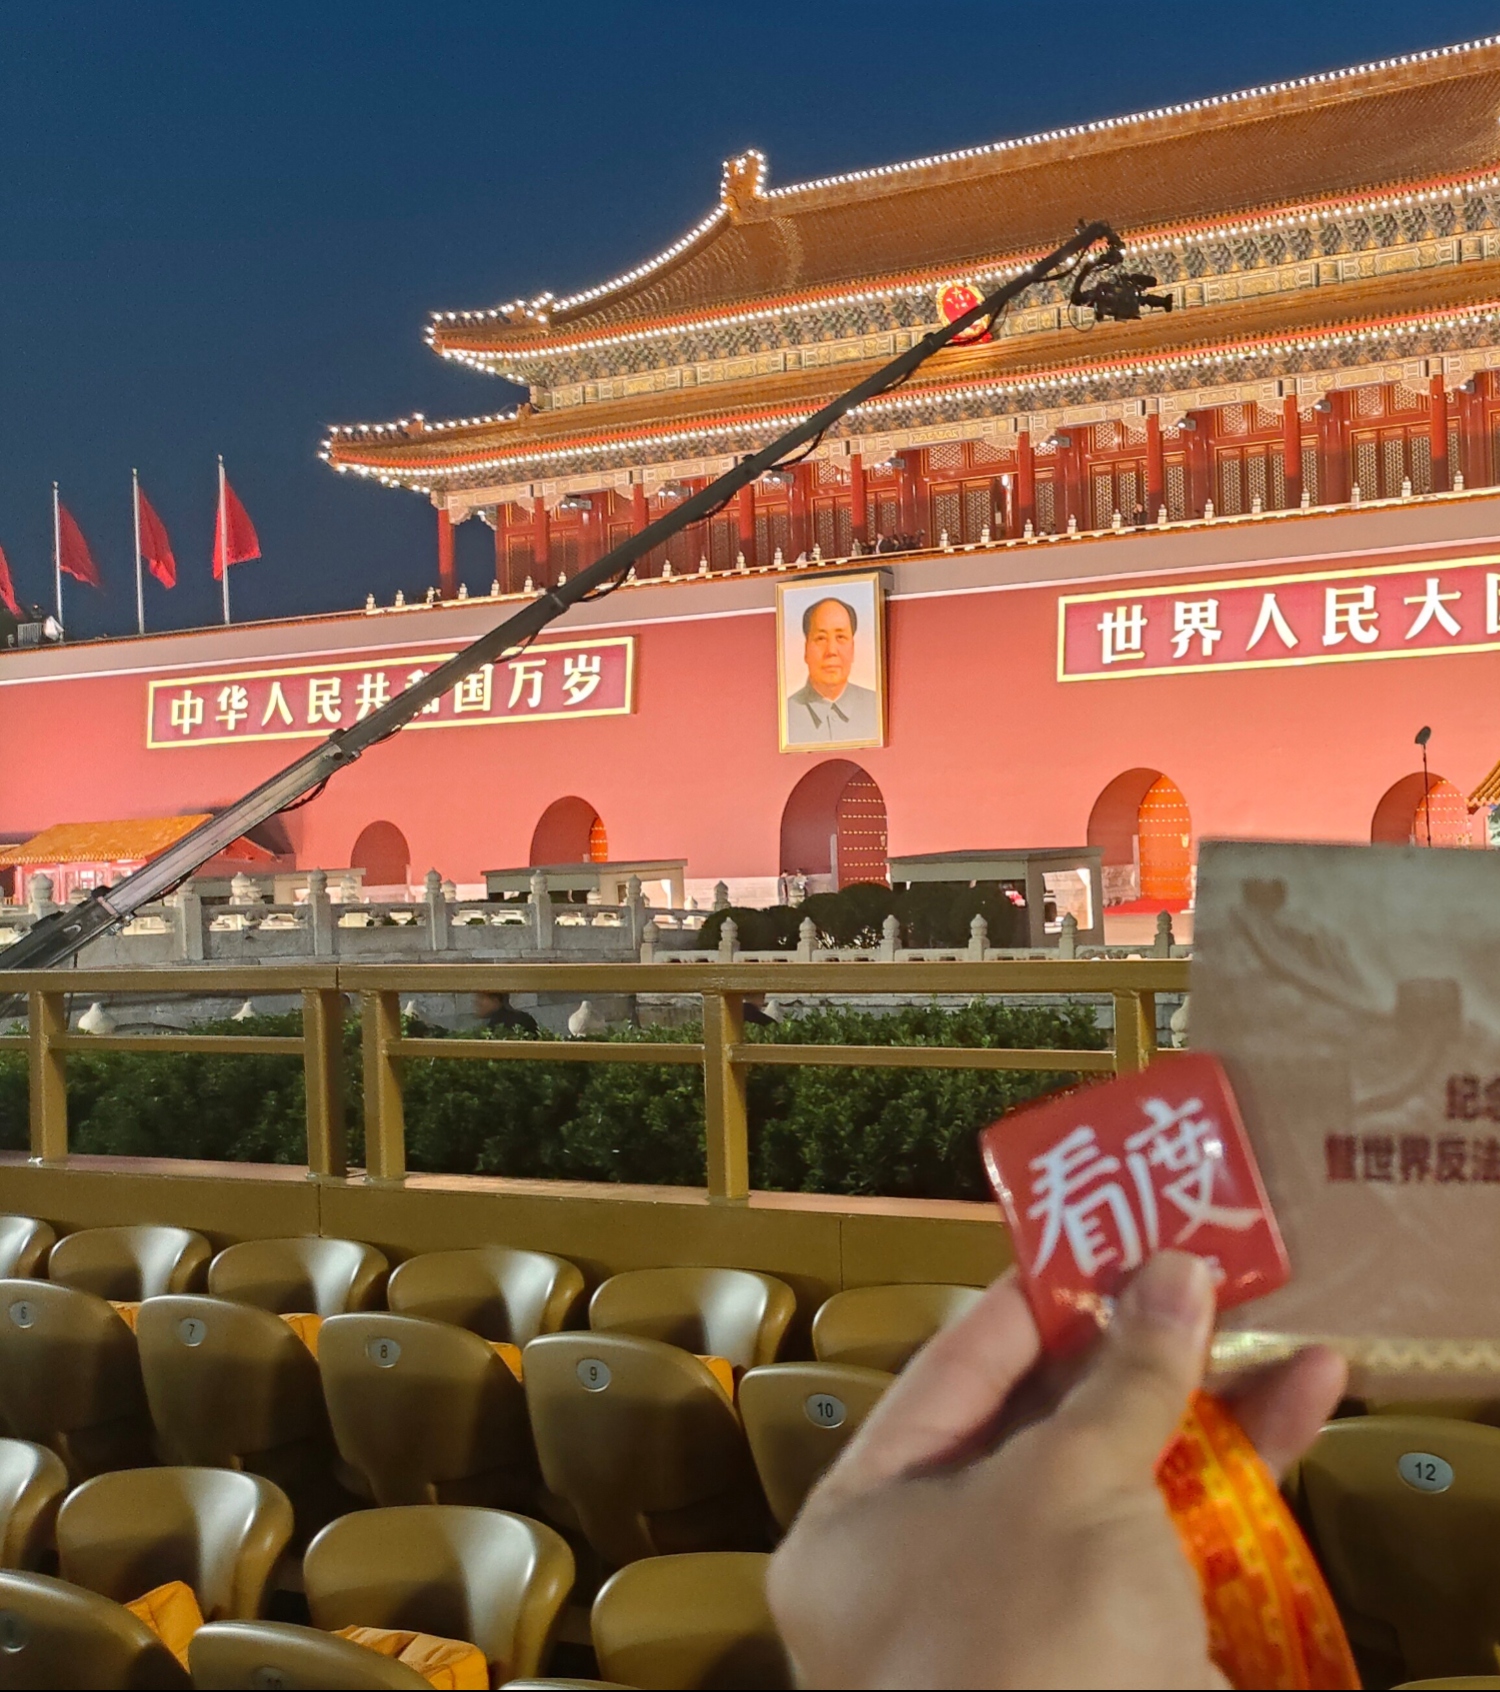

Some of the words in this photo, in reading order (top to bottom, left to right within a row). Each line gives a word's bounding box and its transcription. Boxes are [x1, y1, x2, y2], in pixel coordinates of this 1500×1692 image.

[1026, 1096, 1264, 1279] 看度
[188, 1322, 196, 1338] 7
[380, 1344, 389, 1359] 8
[589, 1365, 598, 1382] 9
[816, 1401, 835, 1419] 10
[1414, 1461, 1437, 1482] 12
